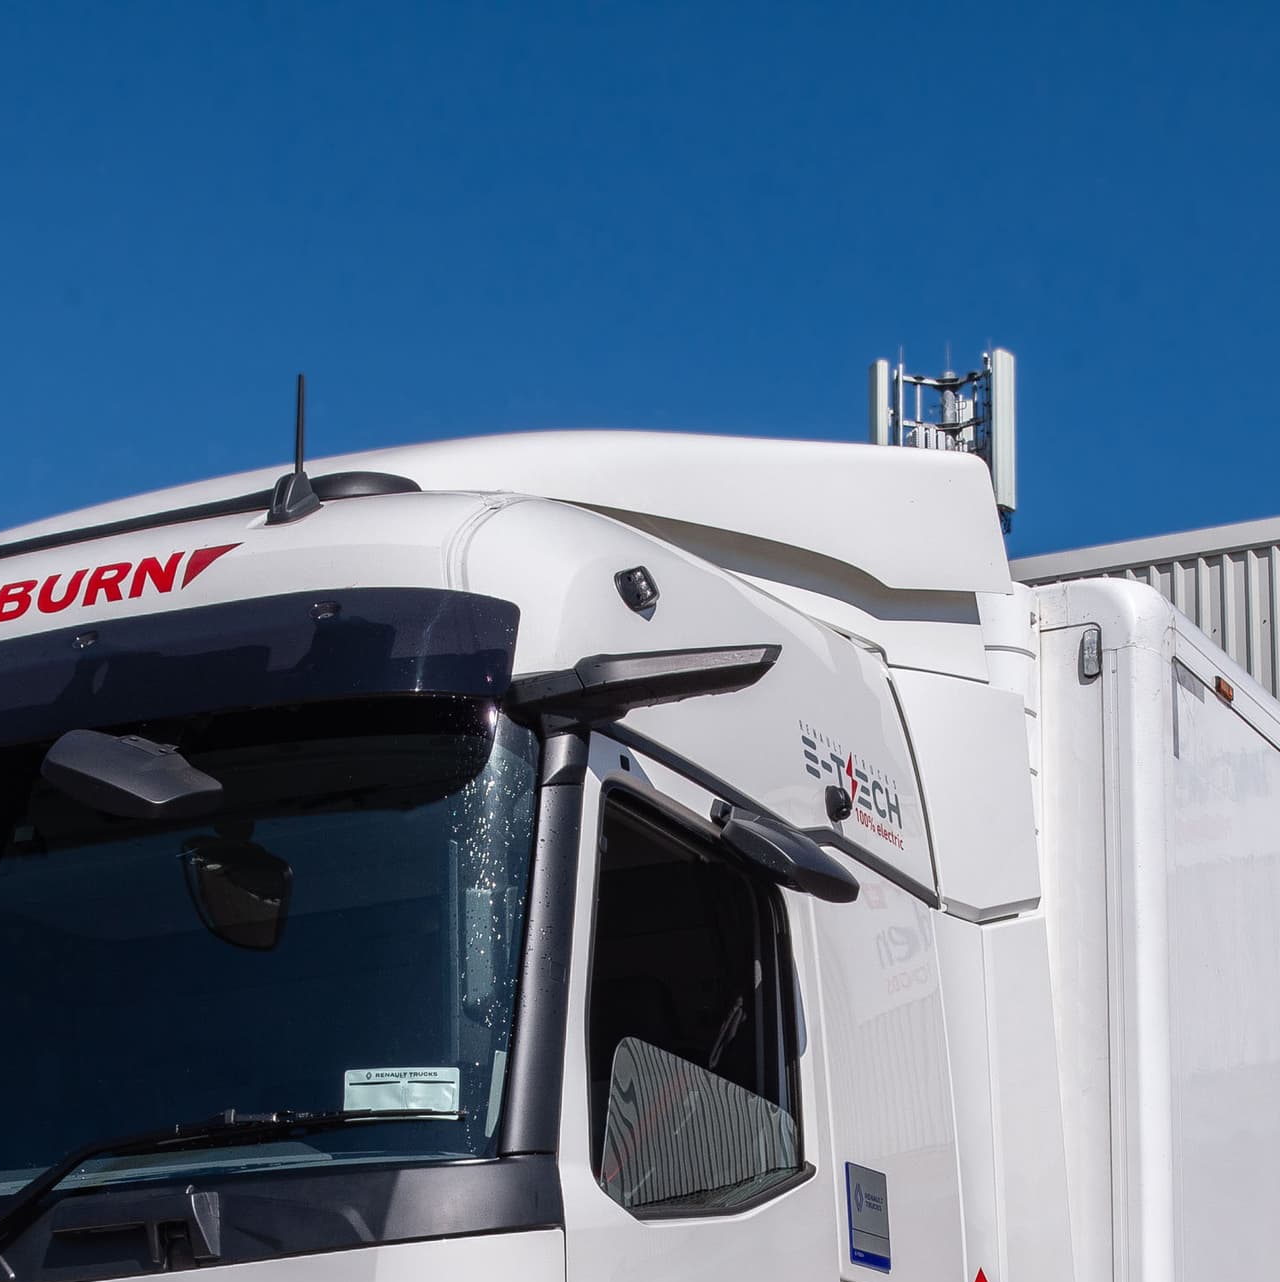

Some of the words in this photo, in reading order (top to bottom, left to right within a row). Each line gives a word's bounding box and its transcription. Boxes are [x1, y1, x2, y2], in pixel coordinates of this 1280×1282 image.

[799, 720, 842, 753] RENAULT
[855, 808, 876, 833] 100%
[877, 823, 905, 851] electric
[409, 1071, 438, 1079] TRUCKS
